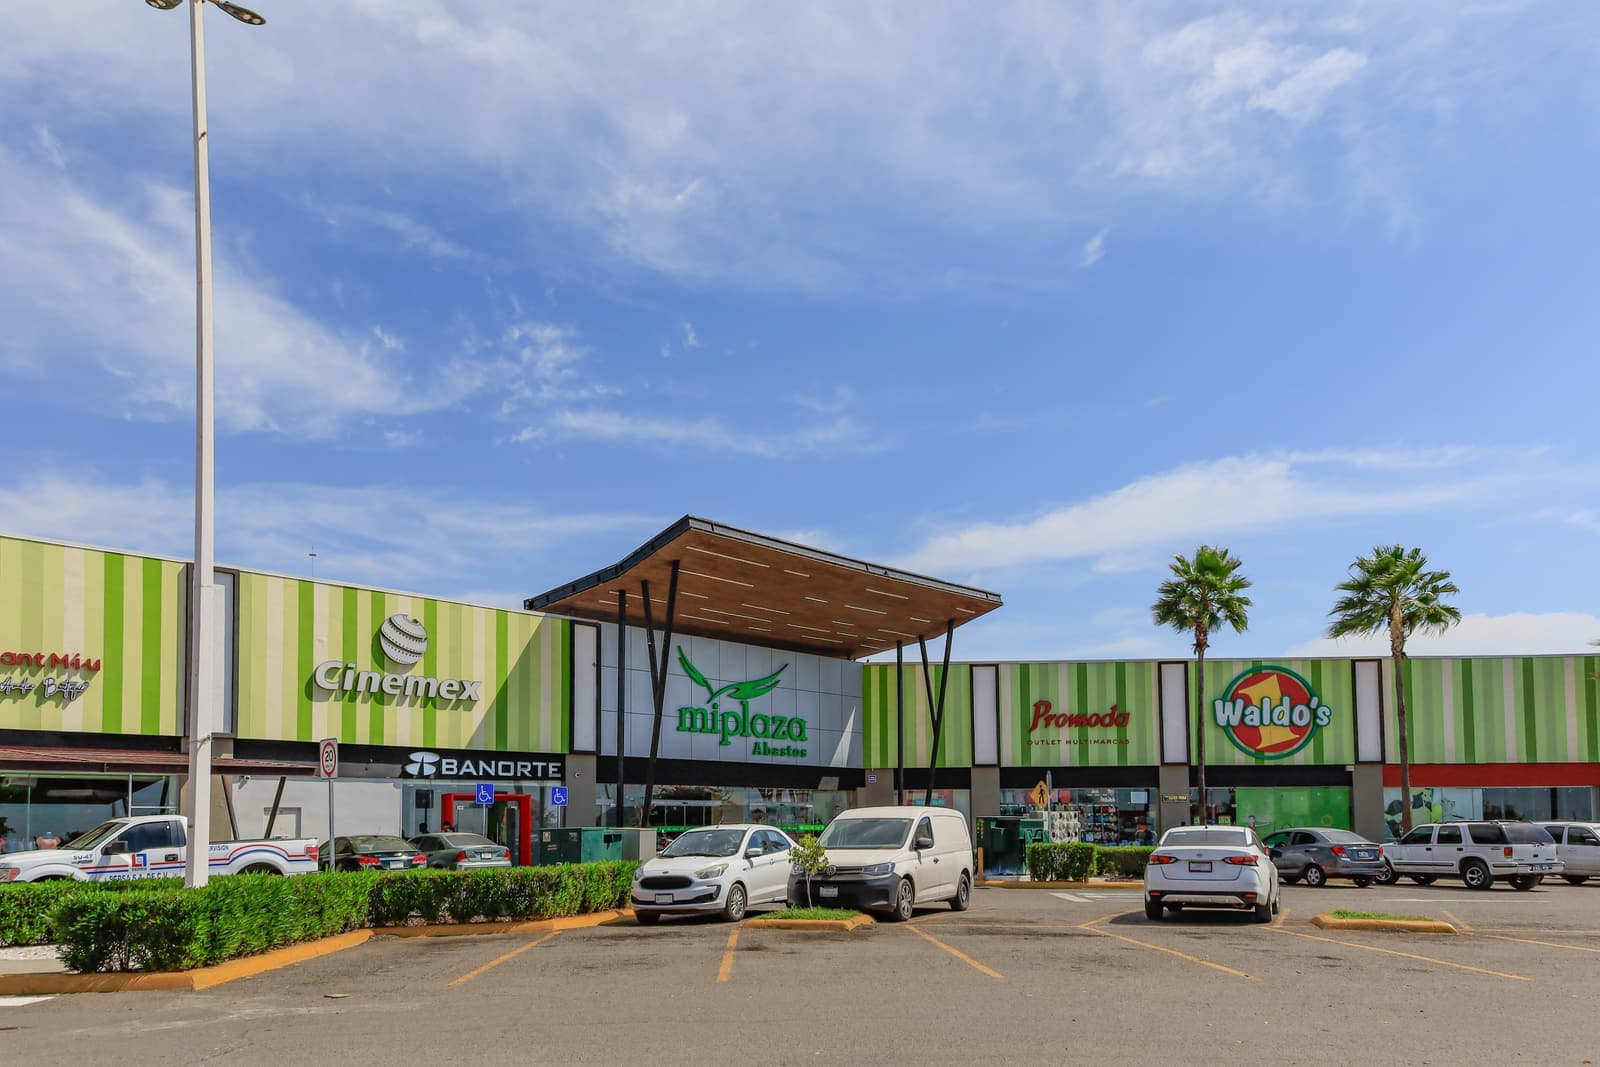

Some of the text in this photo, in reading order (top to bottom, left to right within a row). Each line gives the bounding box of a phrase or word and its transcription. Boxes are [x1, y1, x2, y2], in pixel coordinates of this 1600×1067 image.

[314, 660, 482, 701] Cinemex
[676, 699, 808, 746] miplaza
[1028, 699, 1131, 733] Promoda
[1213, 695, 1332, 728] Waldo's
[324, 749, 334, 762] 20
[752, 741, 808, 758] Abastos
[441, 758, 562, 778] BANORTE
